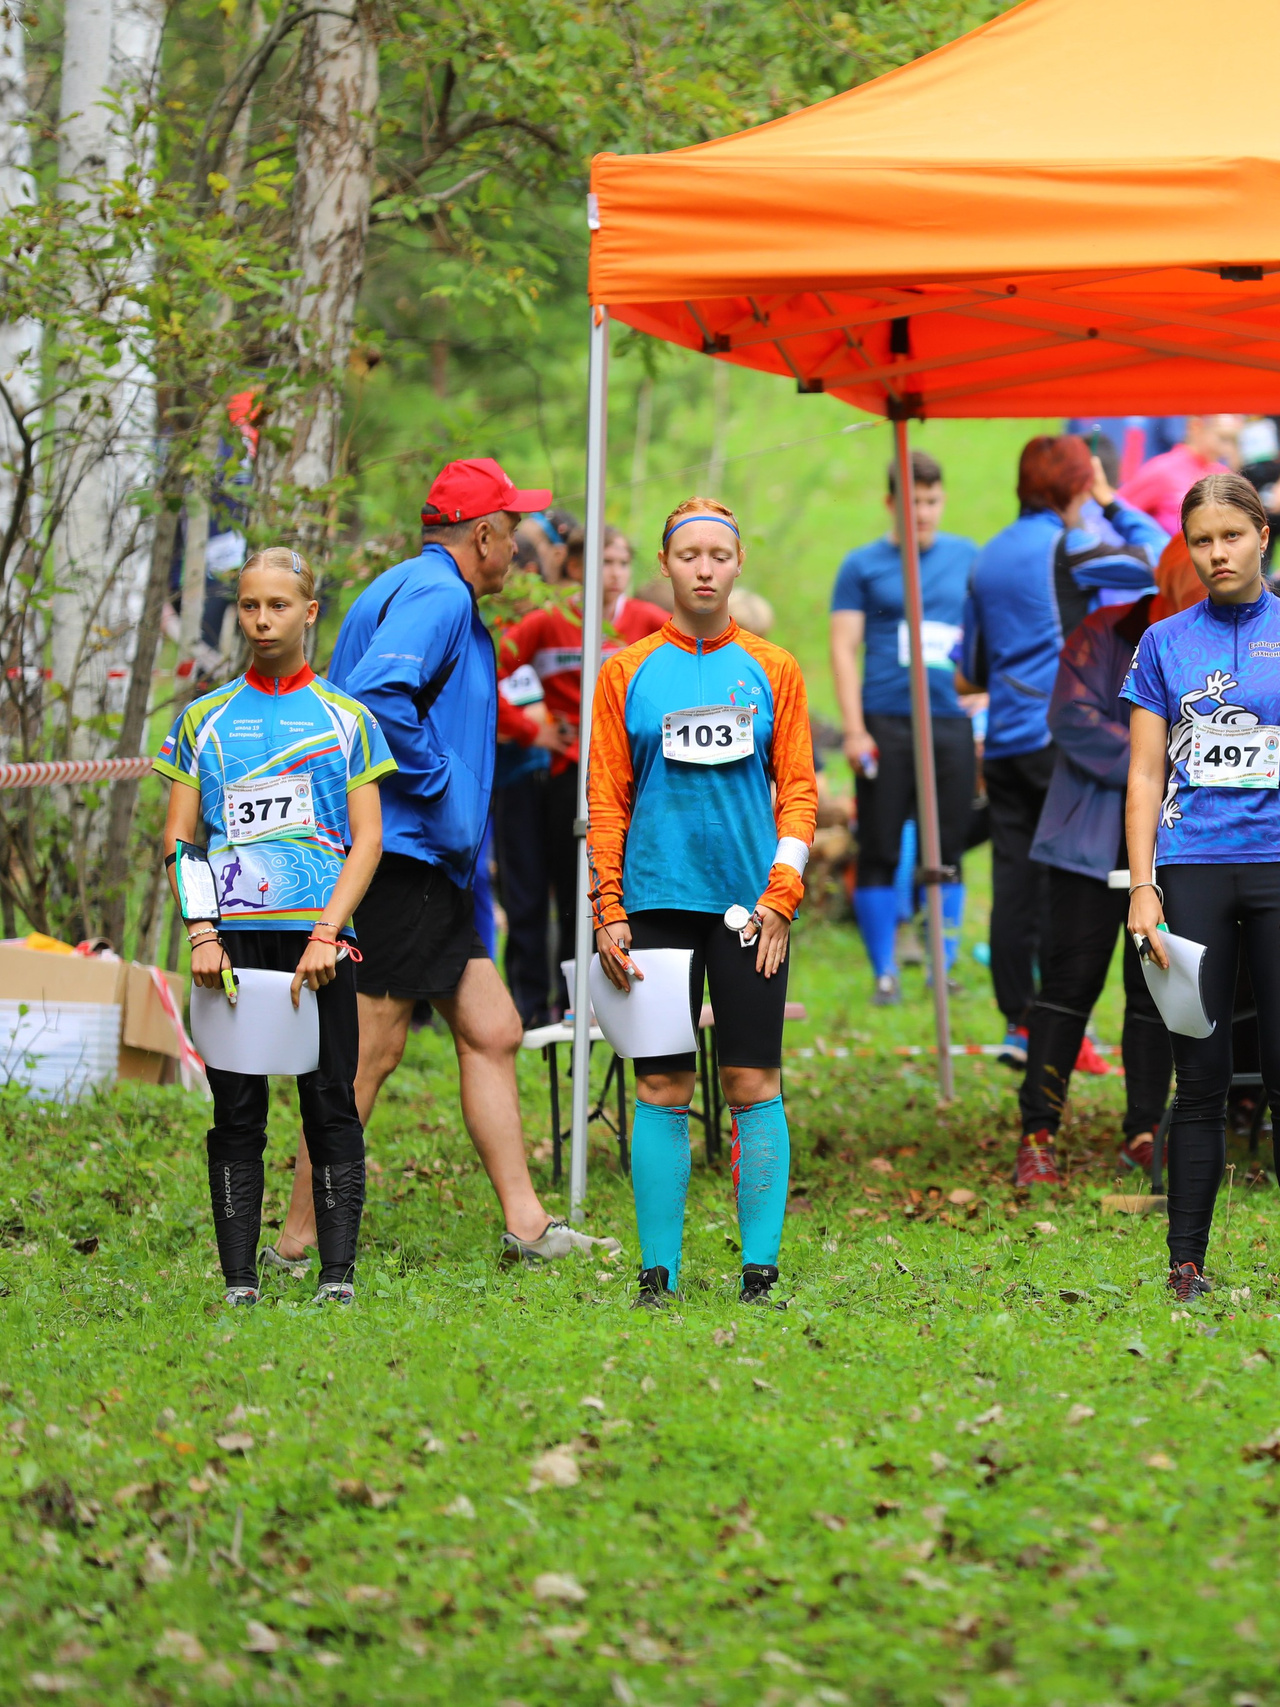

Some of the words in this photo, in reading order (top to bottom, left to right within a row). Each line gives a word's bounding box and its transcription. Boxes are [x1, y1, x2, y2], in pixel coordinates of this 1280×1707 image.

[676, 725, 733, 747] 103
[1203, 745, 1261, 768] 497
[238, 796, 293, 824] 377
